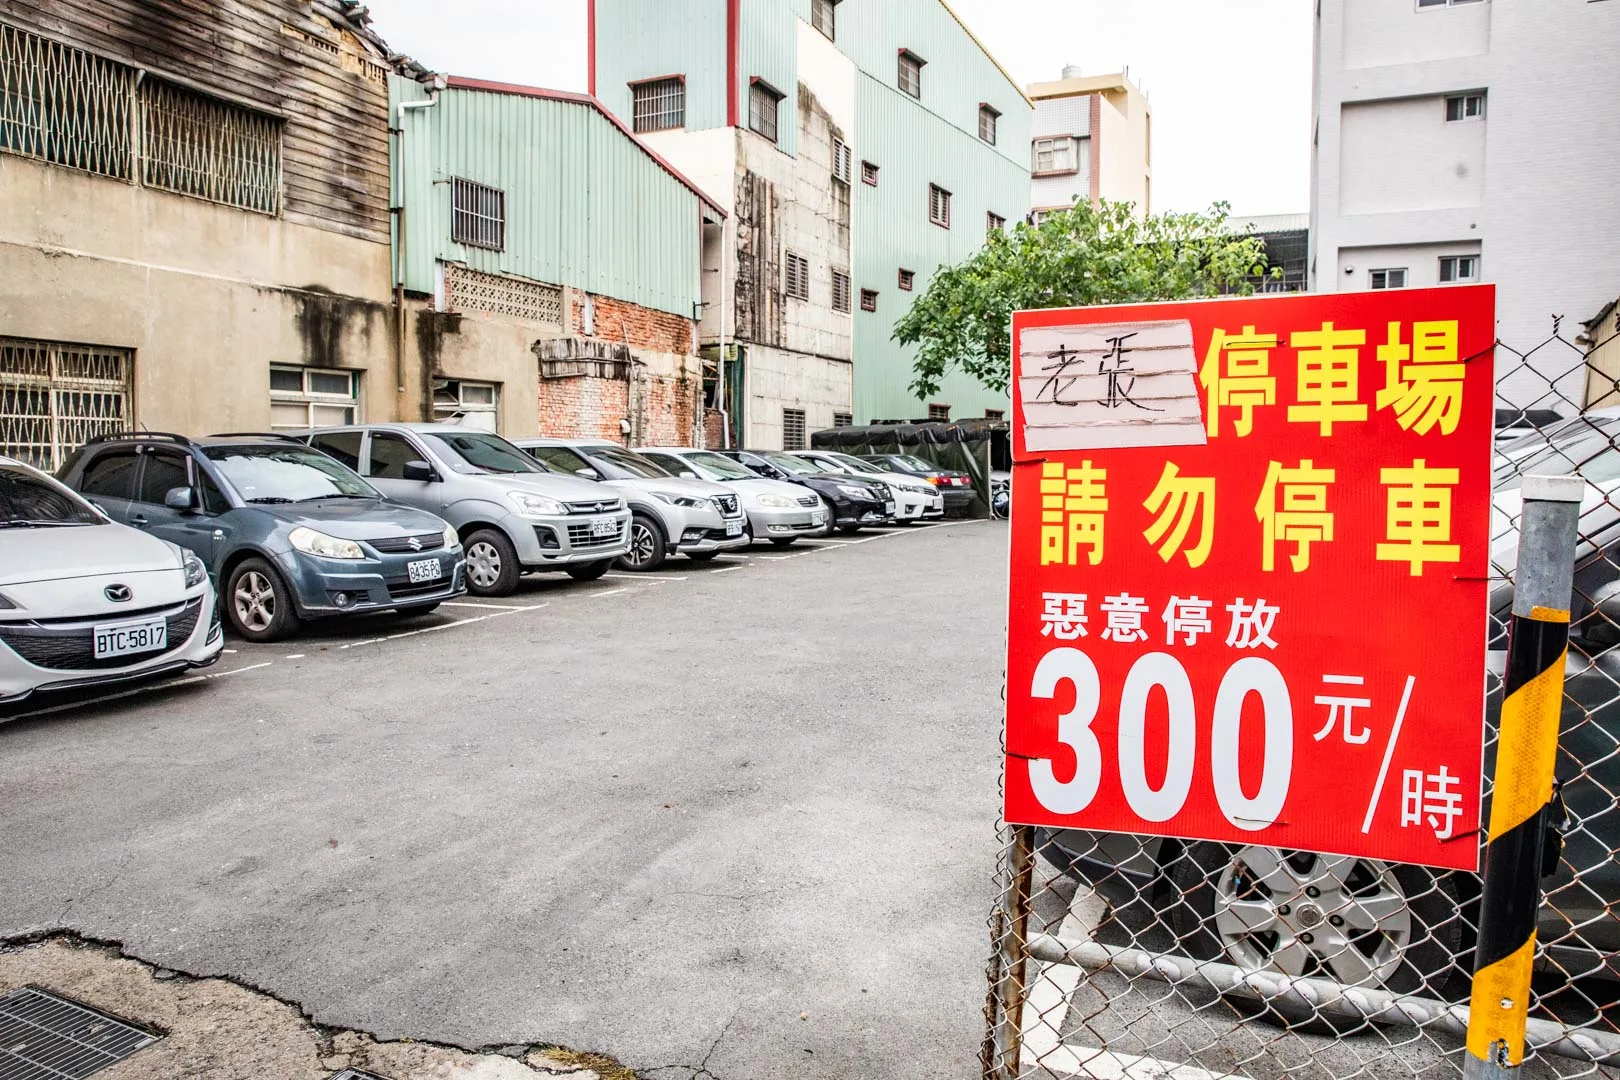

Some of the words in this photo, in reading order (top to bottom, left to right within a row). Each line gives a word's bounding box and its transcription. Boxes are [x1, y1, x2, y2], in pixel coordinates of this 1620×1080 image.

[1036, 332, 1165, 412] 老張
[1200, 320, 1466, 438] 停車場
[1040, 459, 1461, 577] 請勿停車
[1040, 592, 1281, 650] 惡意停放
[1028, 647, 1294, 832] 300
